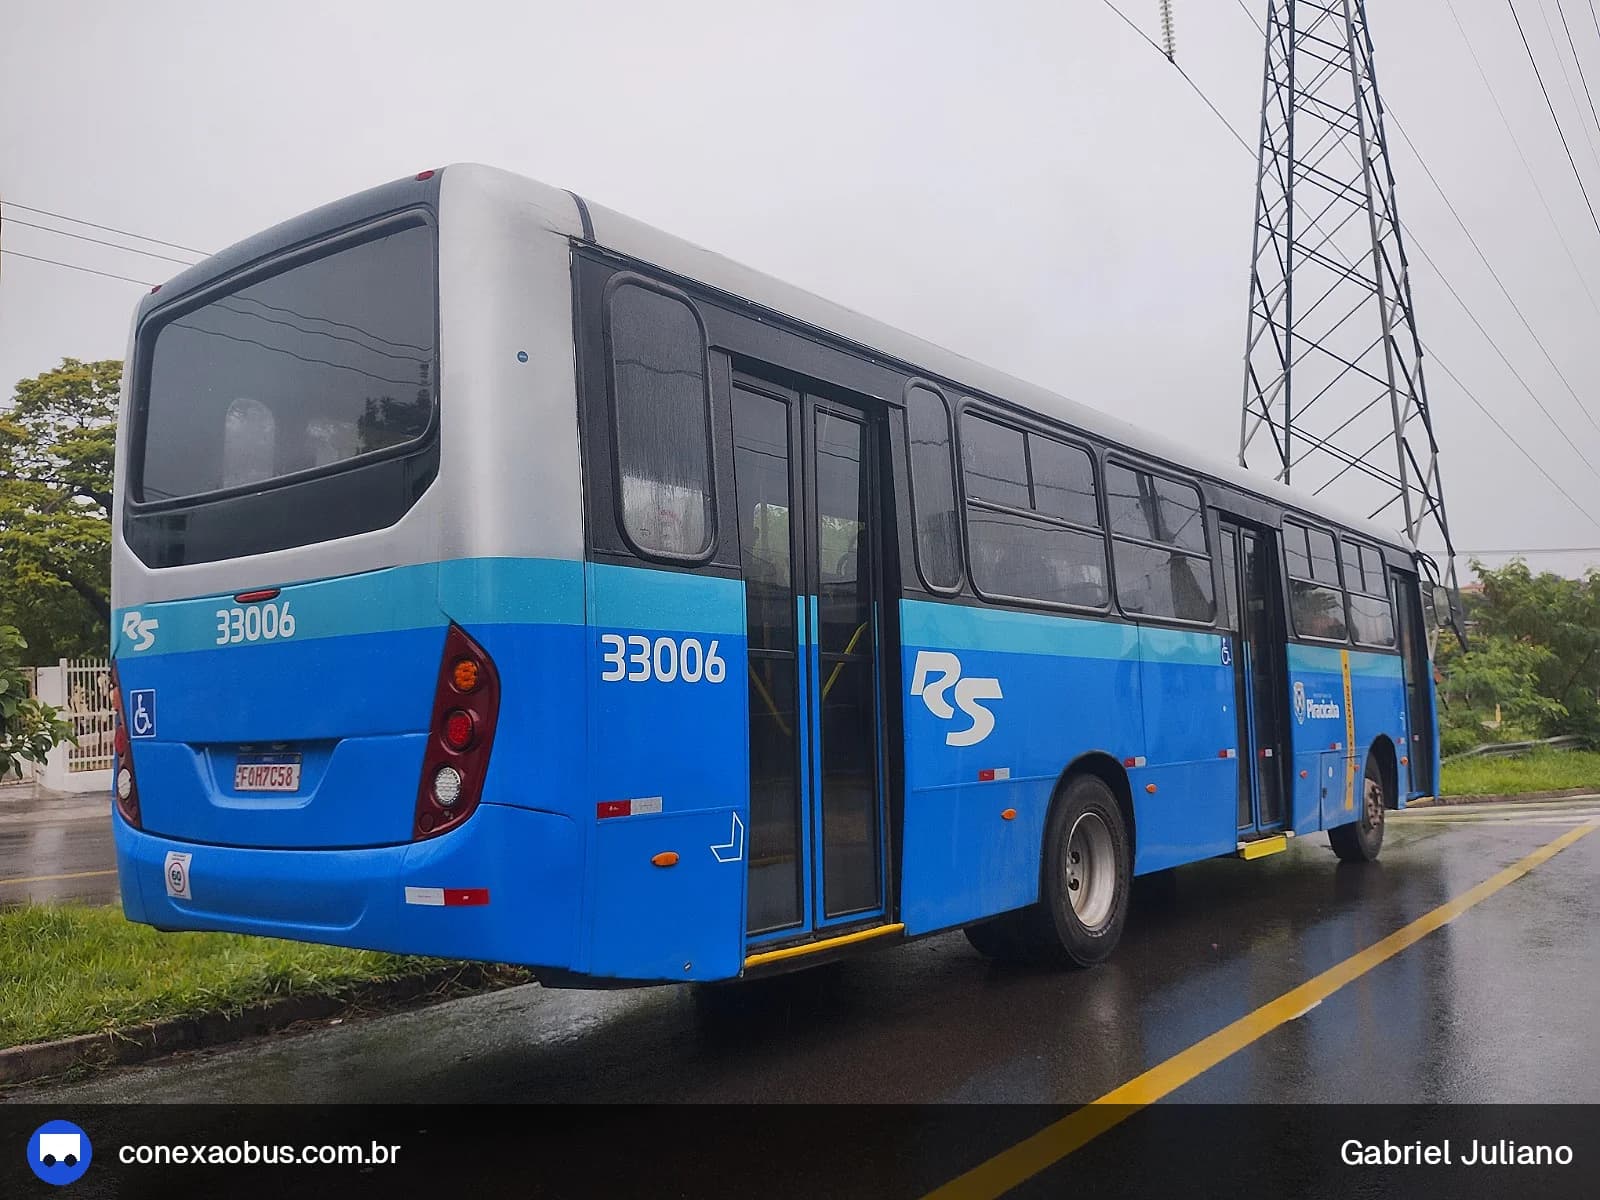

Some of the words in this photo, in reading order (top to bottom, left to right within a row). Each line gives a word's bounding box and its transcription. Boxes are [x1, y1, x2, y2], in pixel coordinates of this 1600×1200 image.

[122, 611, 159, 651] RS
[216, 602, 296, 645] 33006
[601, 634, 727, 683] 33006
[910, 650, 1003, 746] RS
